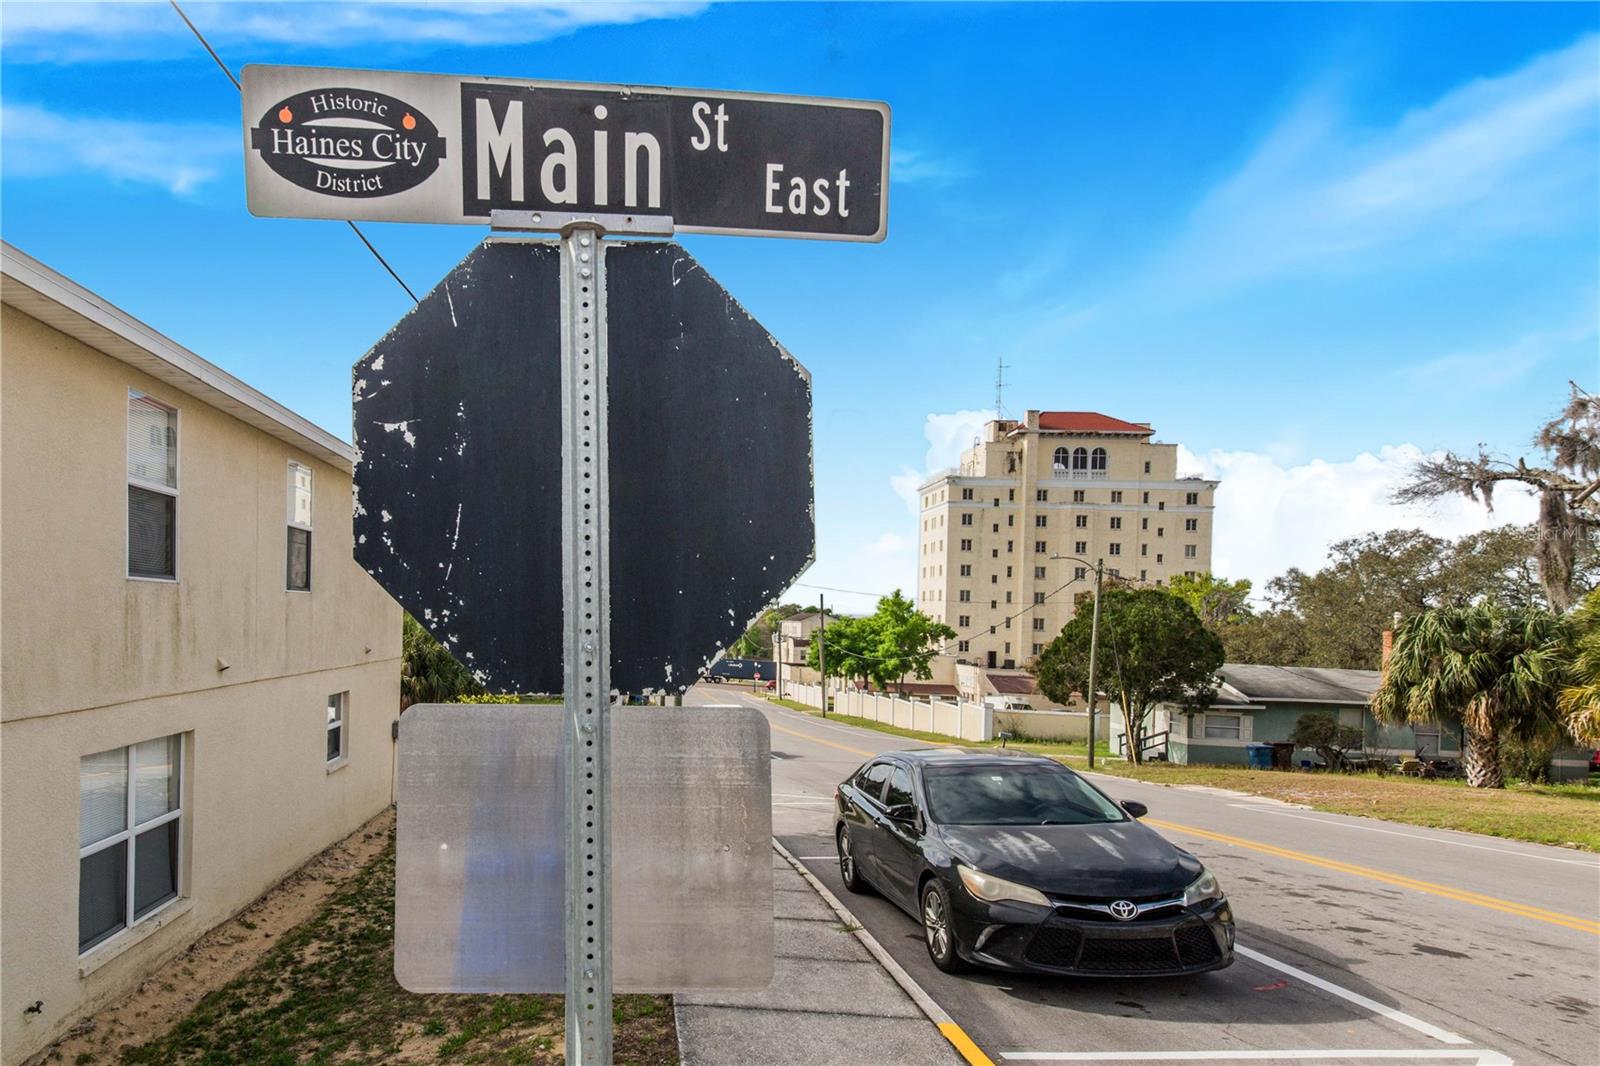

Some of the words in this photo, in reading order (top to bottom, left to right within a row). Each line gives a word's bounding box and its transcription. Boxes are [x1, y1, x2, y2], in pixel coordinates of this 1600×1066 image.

[311, 93, 388, 117] Historic
[271, 128, 363, 158] Haines
[371, 133, 427, 166] City
[475, 98, 661, 208] Main
[690, 101, 729, 152] St
[765, 163, 851, 218] East
[316, 170, 383, 193] District
